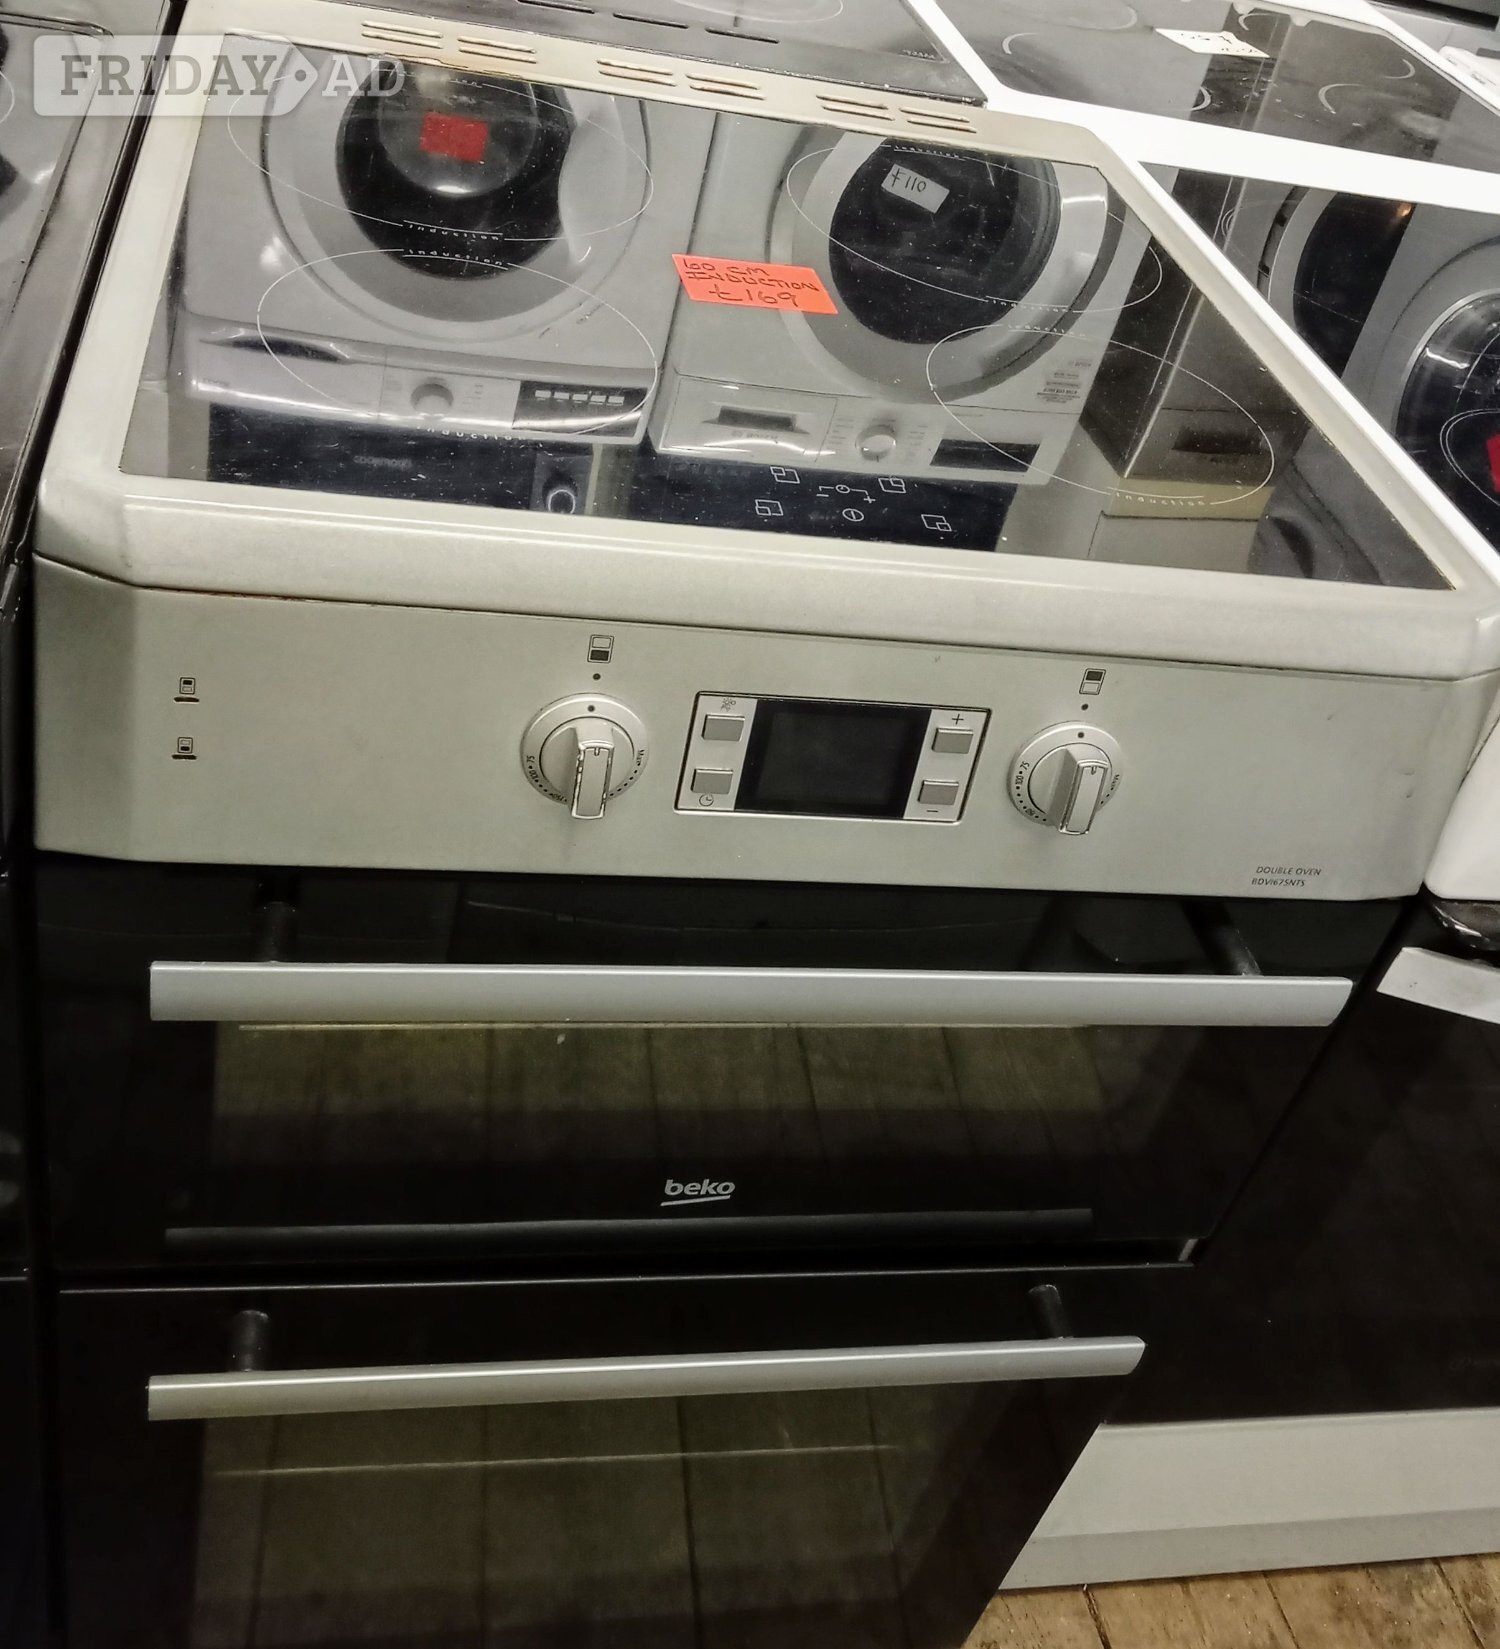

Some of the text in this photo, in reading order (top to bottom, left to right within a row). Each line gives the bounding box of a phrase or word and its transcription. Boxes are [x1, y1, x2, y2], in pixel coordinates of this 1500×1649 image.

[683, 258, 716, 271] 60
[685, 271, 820, 292] INDUCTION
[709, 284, 799, 308] £169
[1020, 760, 1031, 771] 75
[1256, 865, 1323, 877] DOUBLE OVEN
[664, 1178, 736, 1196] beko
